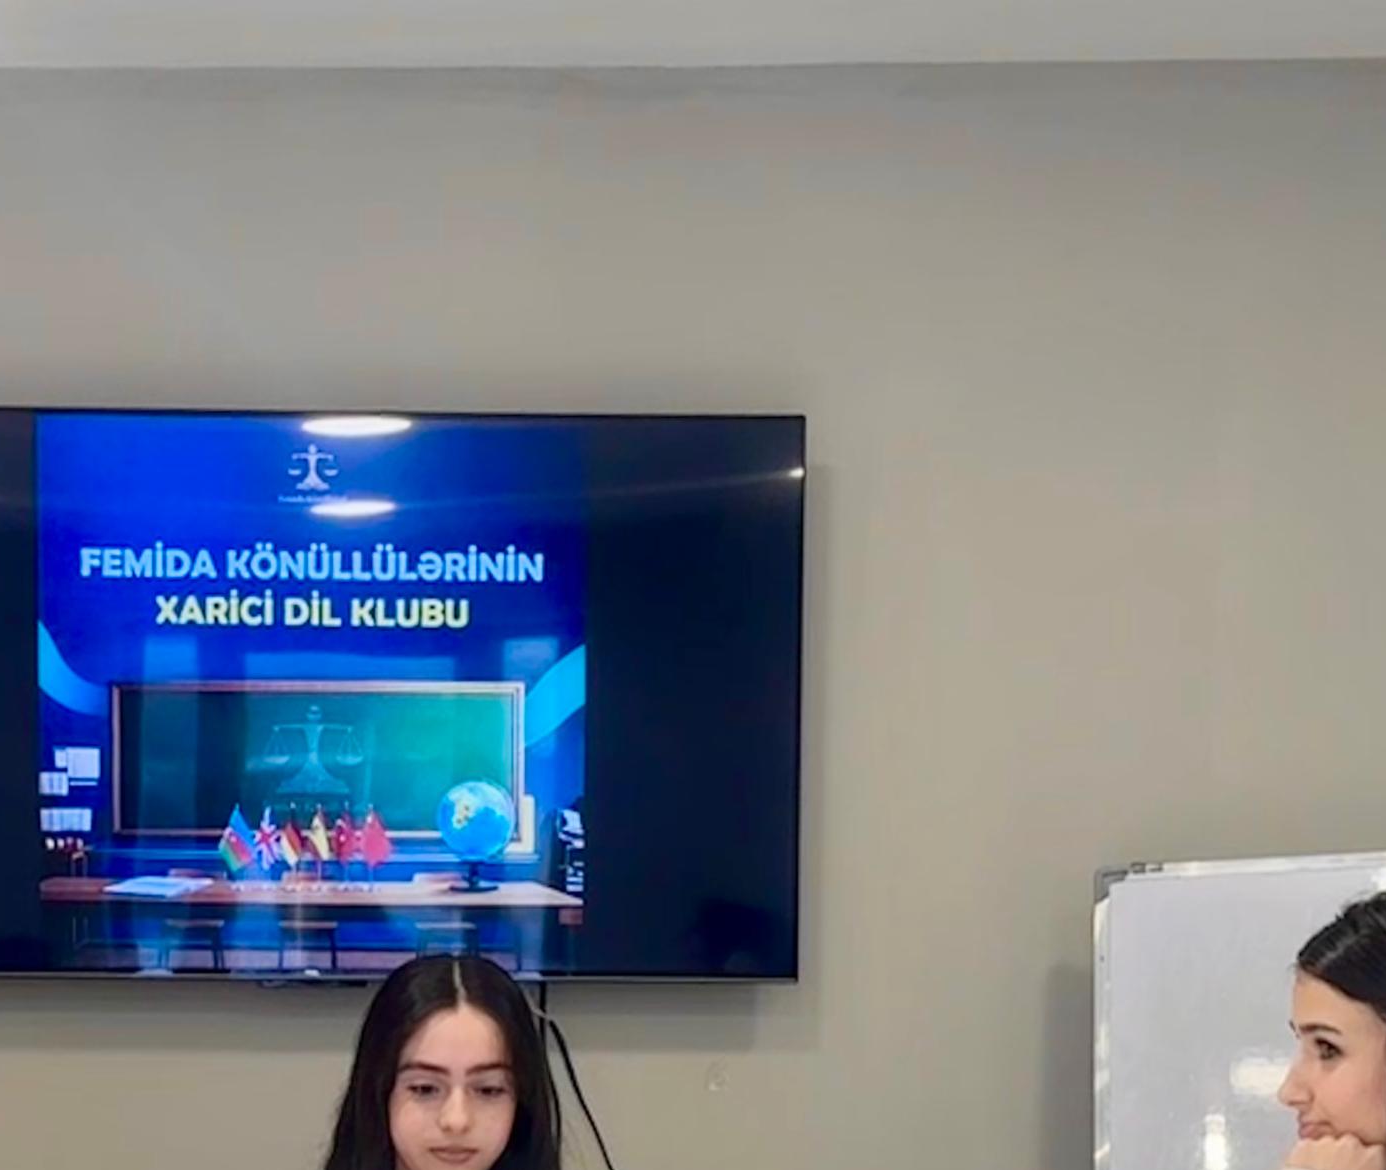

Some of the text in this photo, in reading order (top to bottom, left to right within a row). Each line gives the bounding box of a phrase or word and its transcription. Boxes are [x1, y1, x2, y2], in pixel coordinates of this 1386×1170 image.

[79, 541, 545, 583] FEMİDA KÖNÜLLÜLƏRİNİN
[155, 589, 470, 629] XARİCİ DİL KLUBU
